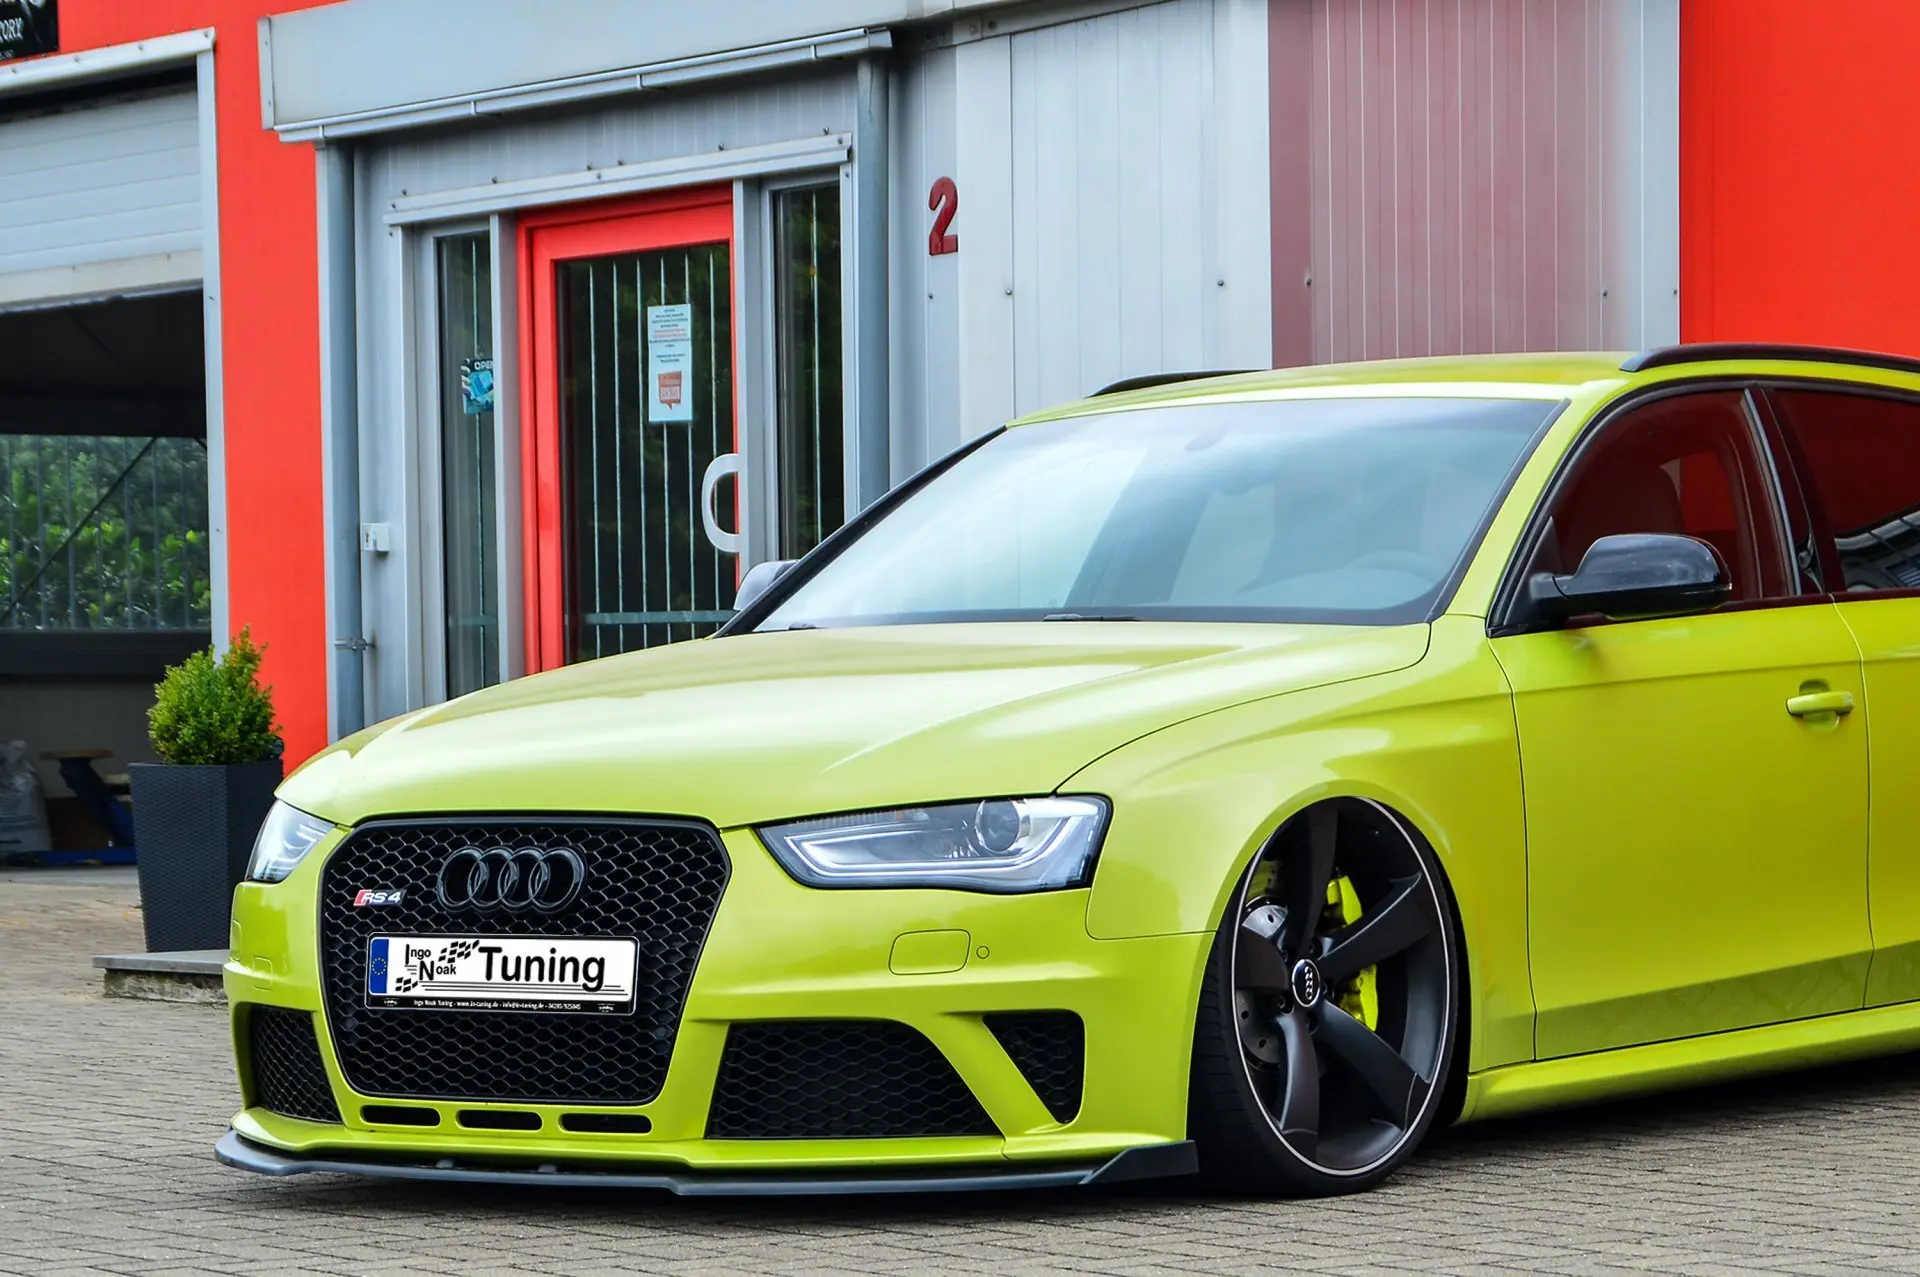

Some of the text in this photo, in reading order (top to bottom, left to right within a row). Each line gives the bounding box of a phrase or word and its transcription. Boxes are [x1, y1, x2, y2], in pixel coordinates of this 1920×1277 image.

[929, 176, 958, 256] 2
[405, 944, 431, 965] Ingo
[419, 960, 456, 981] Noak
[478, 946, 605, 992] Tuning
